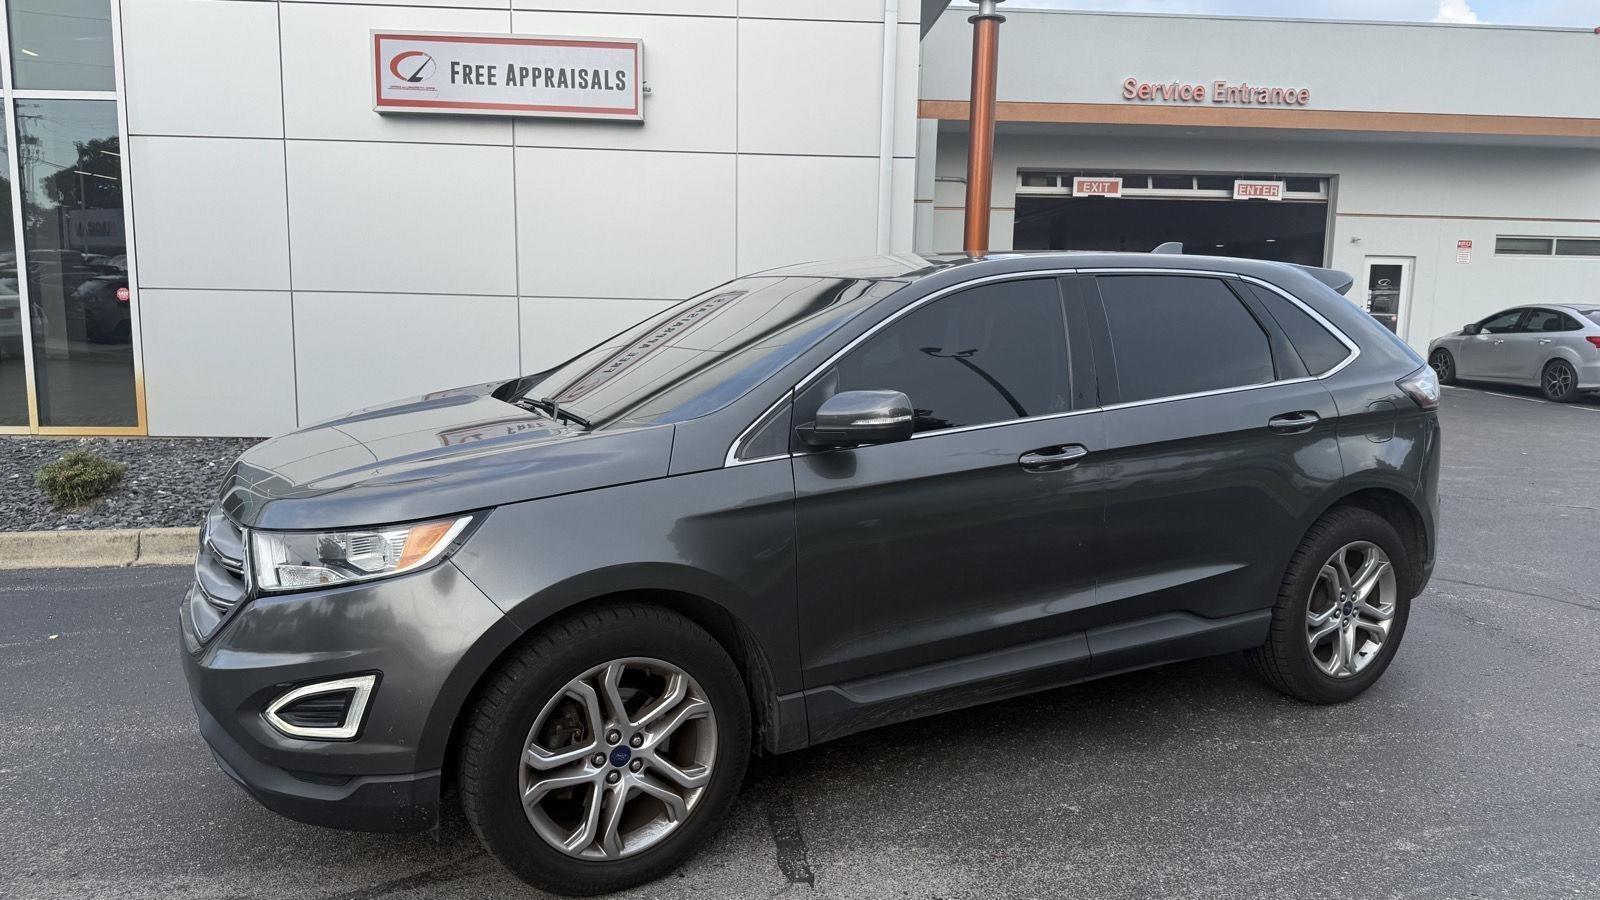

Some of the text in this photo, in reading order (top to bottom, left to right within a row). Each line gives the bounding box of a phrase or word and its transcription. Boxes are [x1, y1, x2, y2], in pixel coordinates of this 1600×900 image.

[450, 61, 626, 91] FREE APPRAISALS
[1122, 77, 1310, 106] Service Entrance
[1082, 182, 1111, 193] EXIT
[1238, 184, 1279, 196] ENTER
